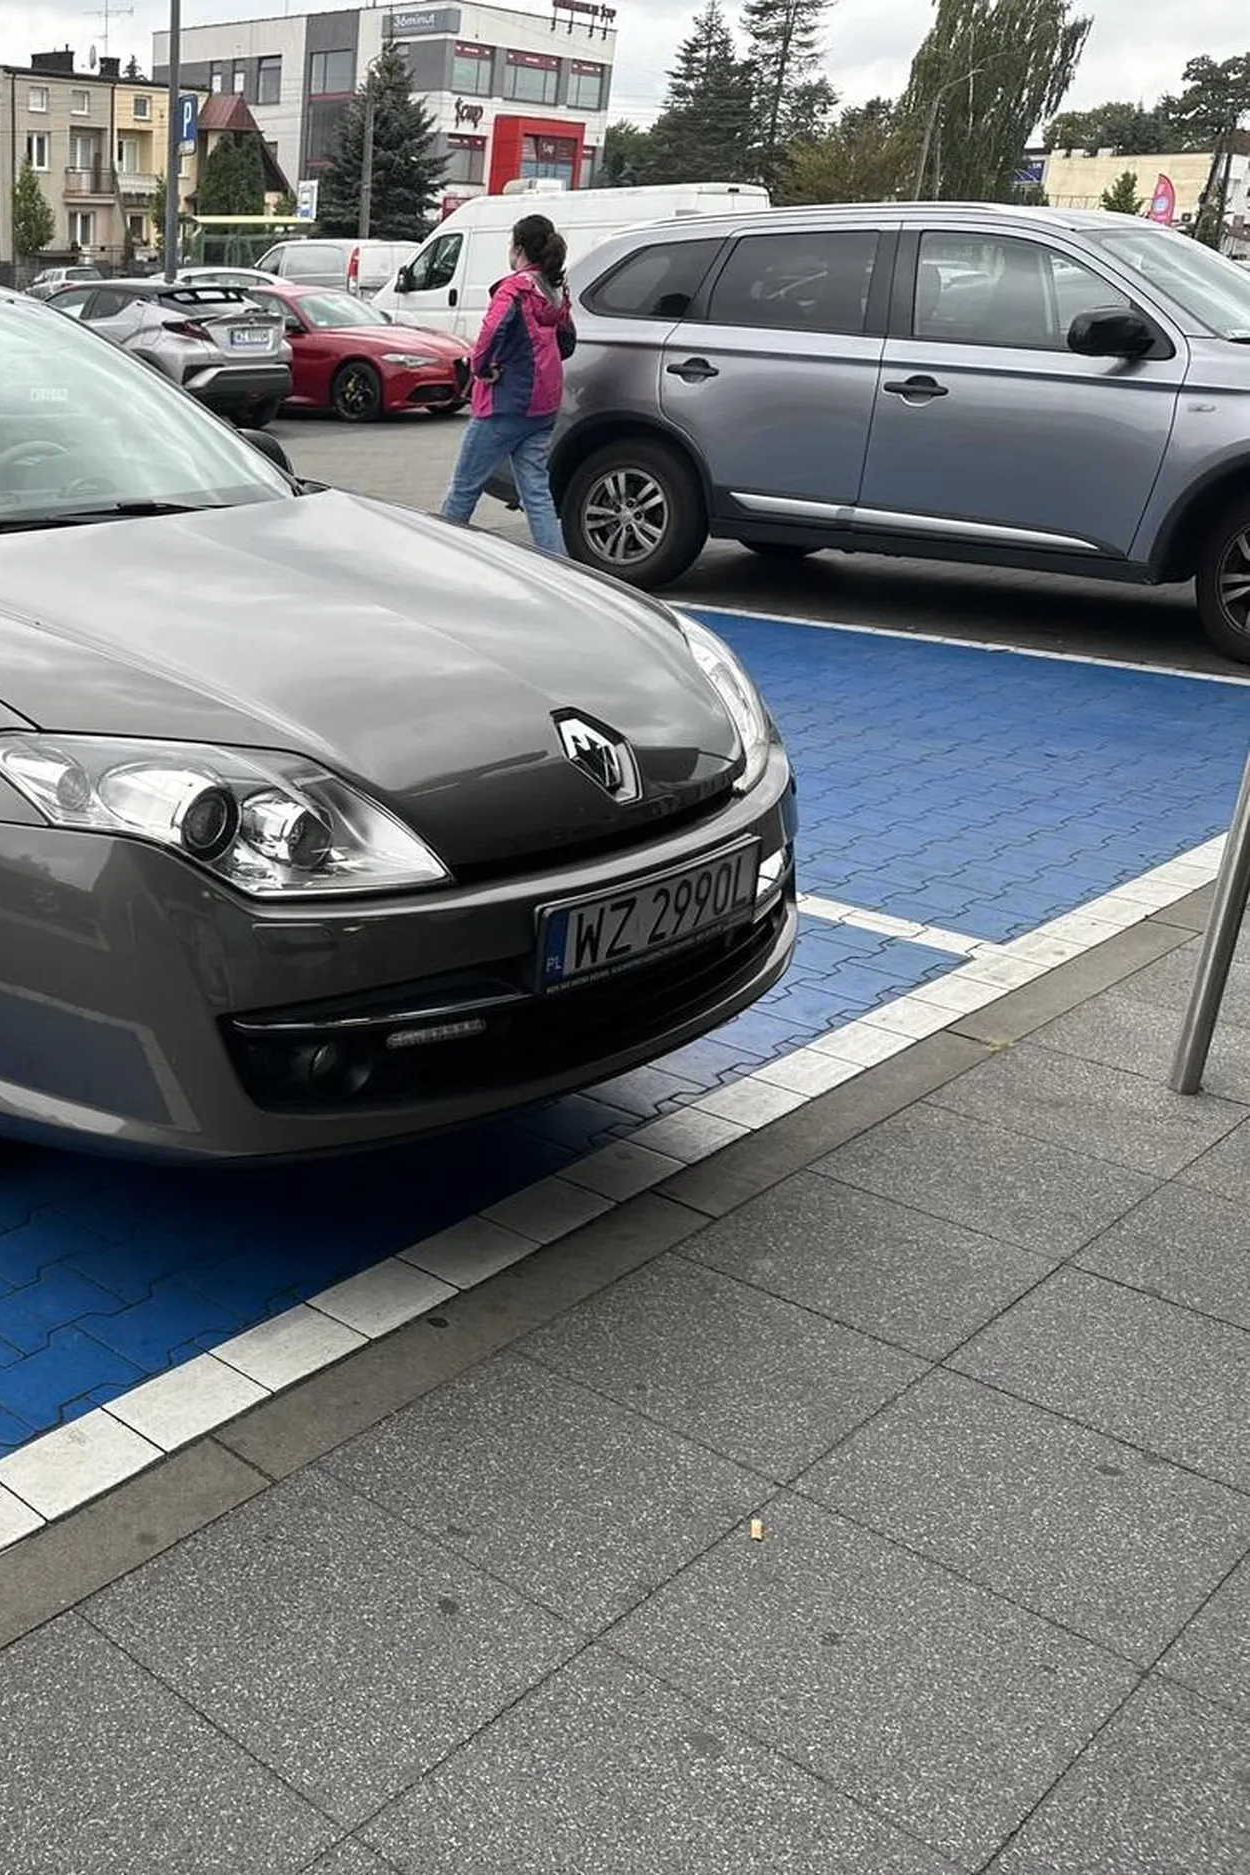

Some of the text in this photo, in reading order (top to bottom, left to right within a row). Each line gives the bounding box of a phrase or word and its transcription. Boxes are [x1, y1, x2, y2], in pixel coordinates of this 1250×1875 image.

[183, 101, 192, 139] P
[574, 896, 638, 969] WZ
[647, 854, 748, 945] 2990L
[546, 956, 563, 973] PL
